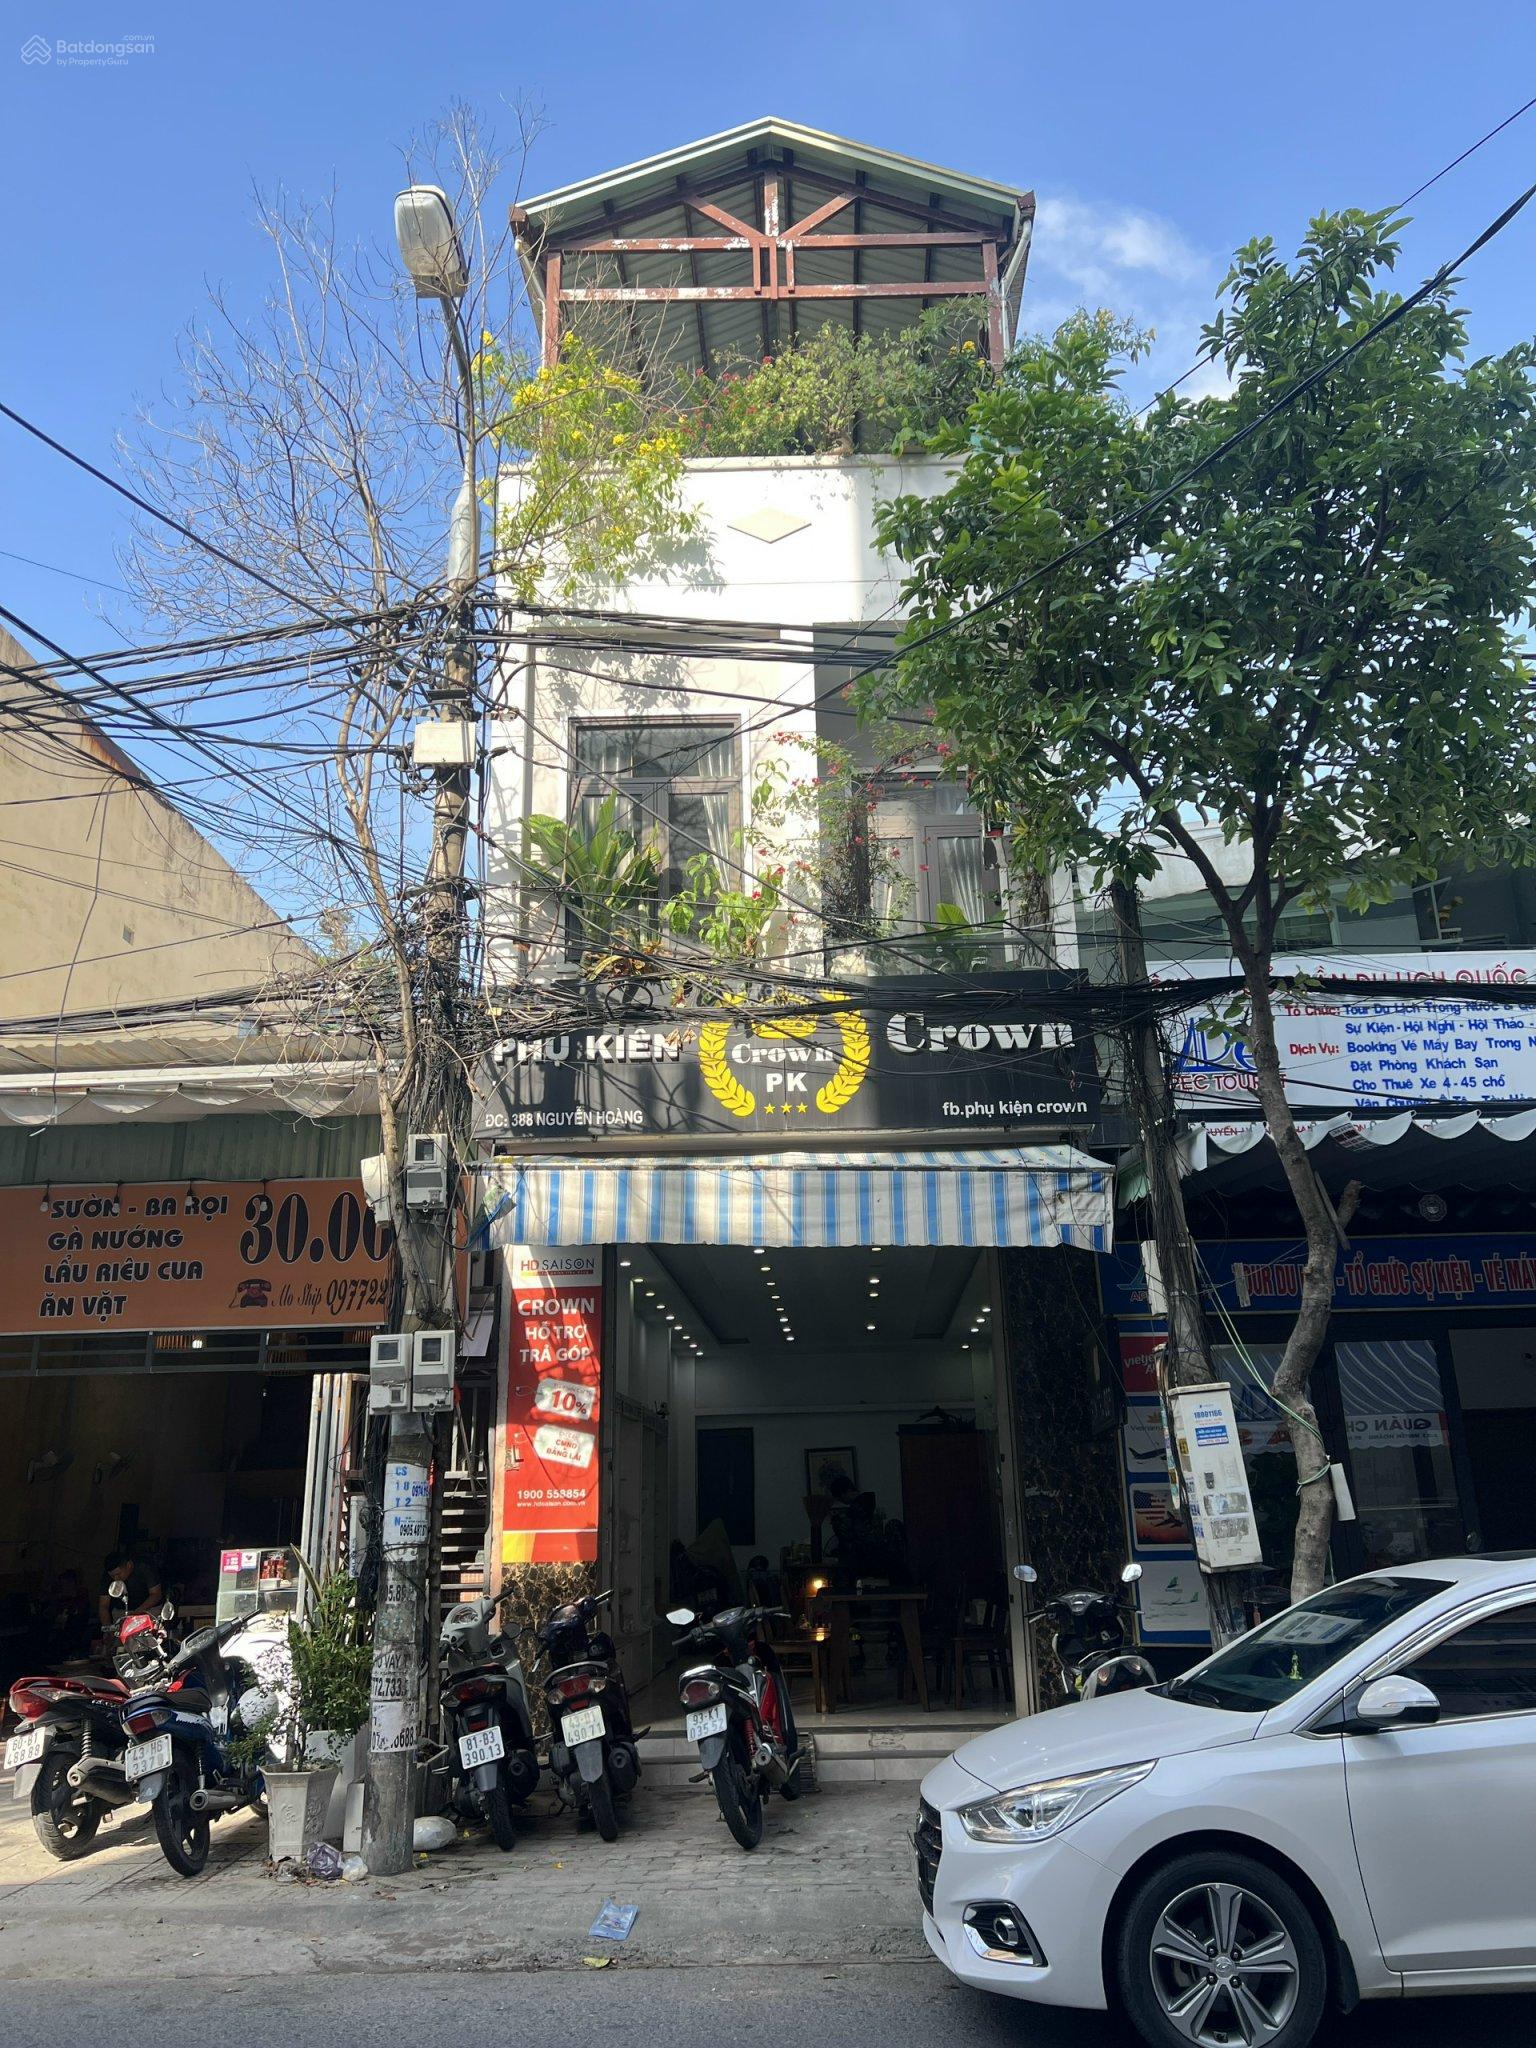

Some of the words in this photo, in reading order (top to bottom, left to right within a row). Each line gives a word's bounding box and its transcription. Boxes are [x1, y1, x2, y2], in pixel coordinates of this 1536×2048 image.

[886, 1011, 1076, 1053] Crown
[493, 1035, 570, 1066] PHỤ
[731, 1043, 834, 1064] Crown
[1290, 1043, 1316, 1056] Dịch
[1347, 1041, 1397, 1055] Booking
[1401, 1039, 1417, 1051] Vé
[1423, 1039, 1449, 1054] Máy
[1454, 1038, 1478, 1052] Bay
[1485, 1037, 1522, 1051] Trong
[1350, 1060, 1373, 1073] Đặt
[1379, 1059, 1418, 1074] Phòng
[1426, 1058, 1467, 1070] Khách
[1474, 1057, 1499, 1070] Sạn
[766, 1072, 808, 1092] PK
[1352, 1079, 1377, 1091] Cho
[1382, 1079, 1414, 1091] Thuê
[1420, 1077, 1437, 1089] Xe
[485, 1114, 508, 1127] ĐC:
[511, 1113, 534, 1127] 388
[537, 1106, 592, 1126] NGUYỄN
[596, 1107, 644, 1125] HOÀNG
[942, 1101, 995, 1118] fb.phụ
[999, 1100, 1033, 1116] kiện
[1036, 1101, 1088, 1113] crown
[51, 1194, 120, 1219] SƯỜN
[145, 1197, 177, 1216] BA
[184, 1195, 229, 1222] RỌI
[47, 1226, 84, 1251] GÀ
[91, 1224, 184, 1249] NƯỚNG
[240, 1190, 393, 1265] 30.00
[44, 1254, 89, 1283] LẨU
[95, 1257, 150, 1283] RIÊU
[157, 1260, 204, 1280] CUA
[521, 1259, 540, 1271] HD
[542, 1258, 595, 1271] SAISON
[1275, 1263, 1302, 1297] DU
[1343, 1250, 1368, 1296] TỔ
[1367, 1256, 1411, 1295] CHỨC
[1410, 1259, 1435, 1302] SỰ
[1433, 1254, 1475, 1300] KIỆN
[39, 1292, 75, 1317] ĂN
[81, 1290, 128, 1323] VẶT
[517, 1297, 595, 1317] CROWN
[525, 1321, 551, 1340] HỖ
[553, 1323, 588, 1343] TRỢ
[520, 1344, 552, 1363] TRẢ
[556, 1345, 592, 1362] GÓP
[551, 1389, 587, 1415] 10%
[517, 1489, 543, 1500] 1900
[692, 1707, 719, 1726] 93-K1
[466, 1731, 495, 1751] 81-B3
[465, 1743, 502, 1766] 390.13
